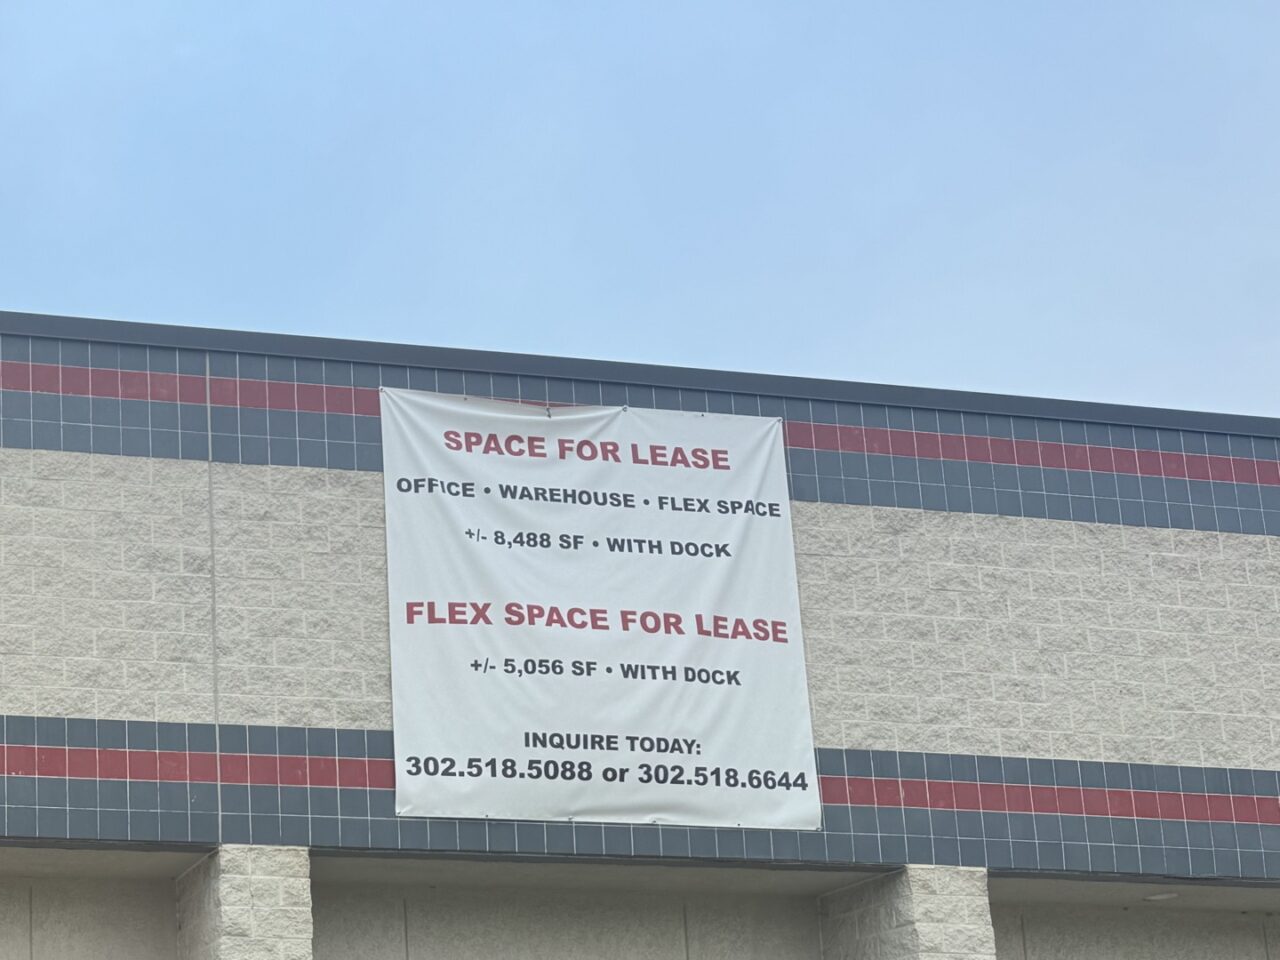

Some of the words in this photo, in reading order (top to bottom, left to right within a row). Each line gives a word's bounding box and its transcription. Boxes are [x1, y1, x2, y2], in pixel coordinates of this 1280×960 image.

[443, 429, 548, 459] SPACE
[556, 437, 622, 464] FOR
[630, 442, 731, 471] LEASE
[395, 476, 476, 499] OFFICE
[497, 483, 637, 509] WAREHOUSE
[657, 495, 712, 514] FLEX
[716, 499, 782, 518] SPACE
[464, 526, 488, 543] +/-
[493, 529, 552, 550] 8,488
[558, 533, 585, 551] SF
[605, 536, 664, 555] WITH
[669, 540, 733, 559] DOCK
[405, 600, 494, 626] FLEX
[503, 601, 611, 631] SPACE
[619, 609, 686, 636] FOR
[694, 613, 789, 644] LEASE
[469, 656, 497, 674] +/-
[503, 657, 565, 679] 5,056
[570, 659, 598, 677] SF
[619, 662, 678, 682] WITH
[683, 665, 743, 687] DOCK
[523, 731, 620, 752] INQUIRE
[624, 735, 702, 756] TODAY:
[404, 755, 593, 782] 302.518.5088
[601, 766, 631, 783] or
[637, 762, 809, 792] 302.518.6644
